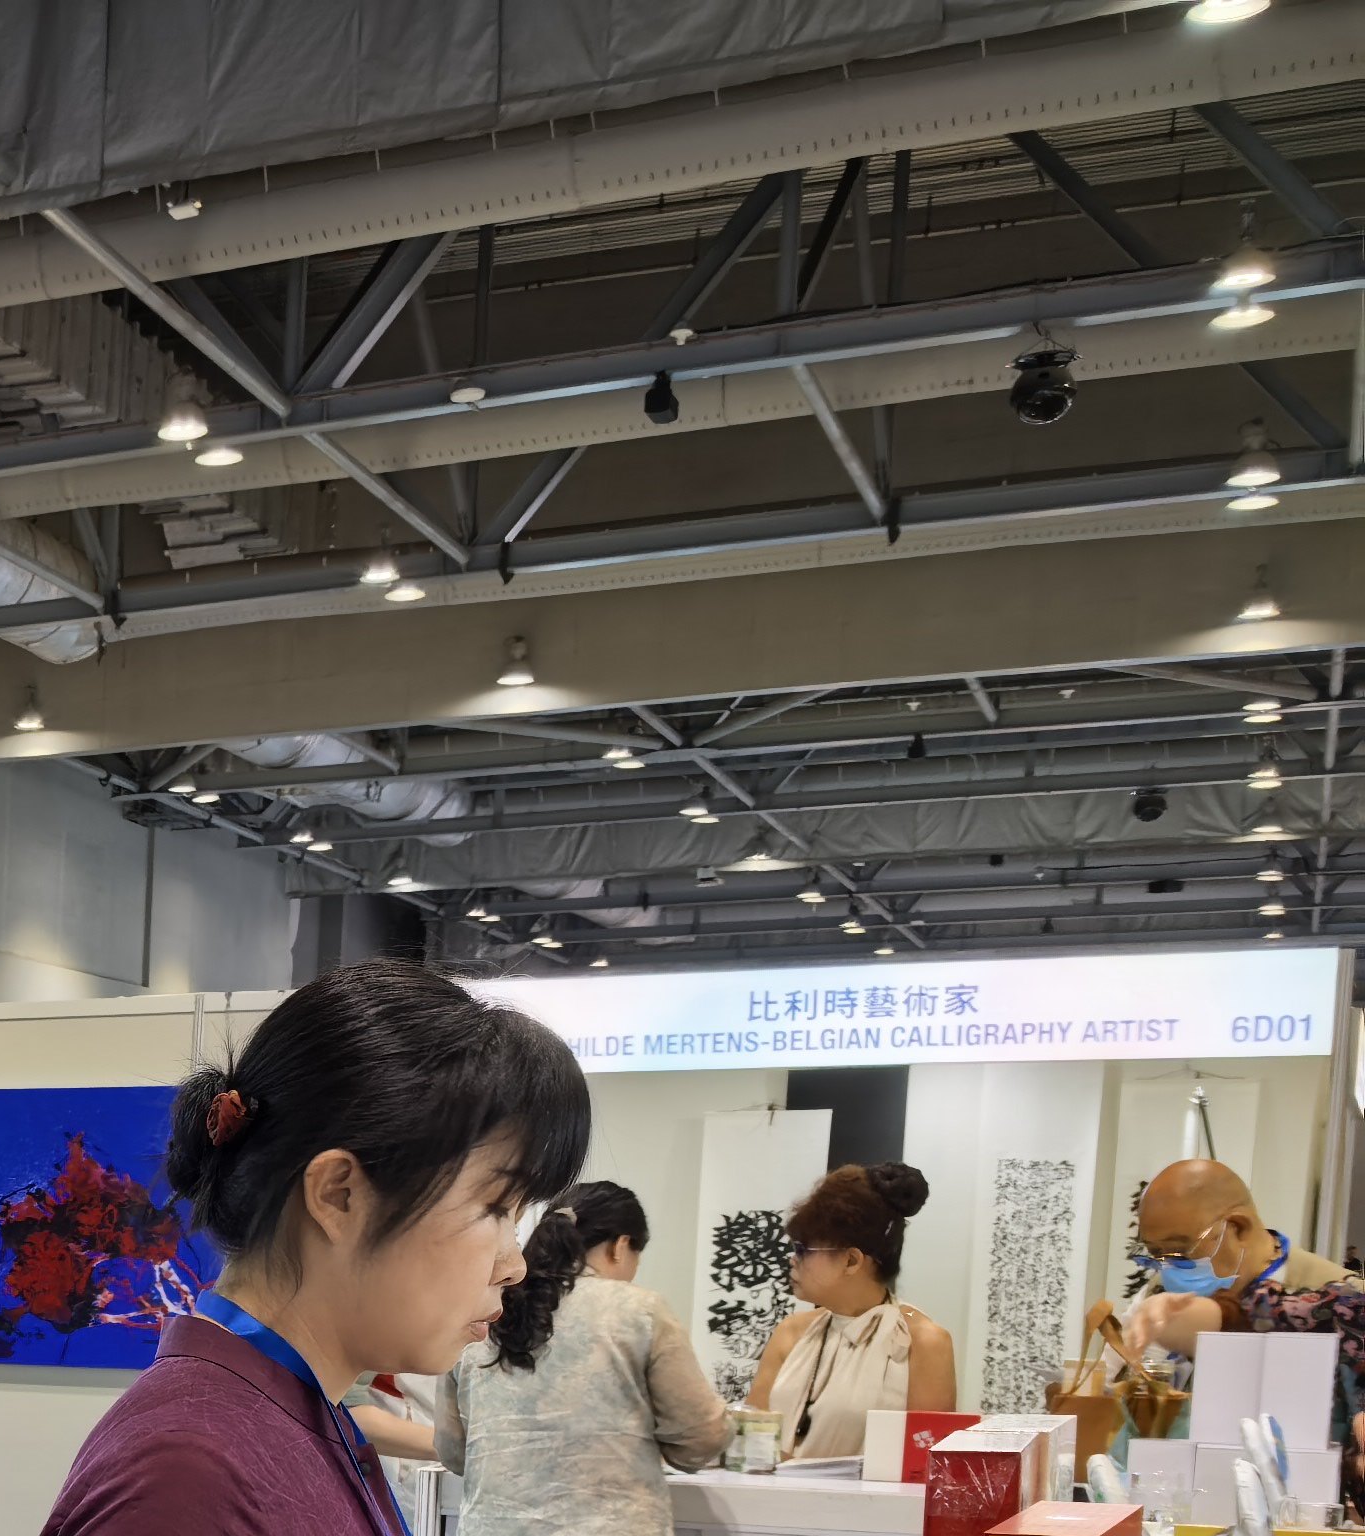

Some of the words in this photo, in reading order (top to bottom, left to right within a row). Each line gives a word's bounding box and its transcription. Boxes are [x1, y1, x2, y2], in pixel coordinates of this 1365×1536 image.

[747, 984, 980, 1022] 比利時藝術家
[643, 1027, 881, 1055] MERTENS-BELGIAN
[890, 1022, 1073, 1049] CALLIGRAPHY
[1082, 1019, 1180, 1043] ARTIST
[1231, 1014, 1313, 1043] 6D01
